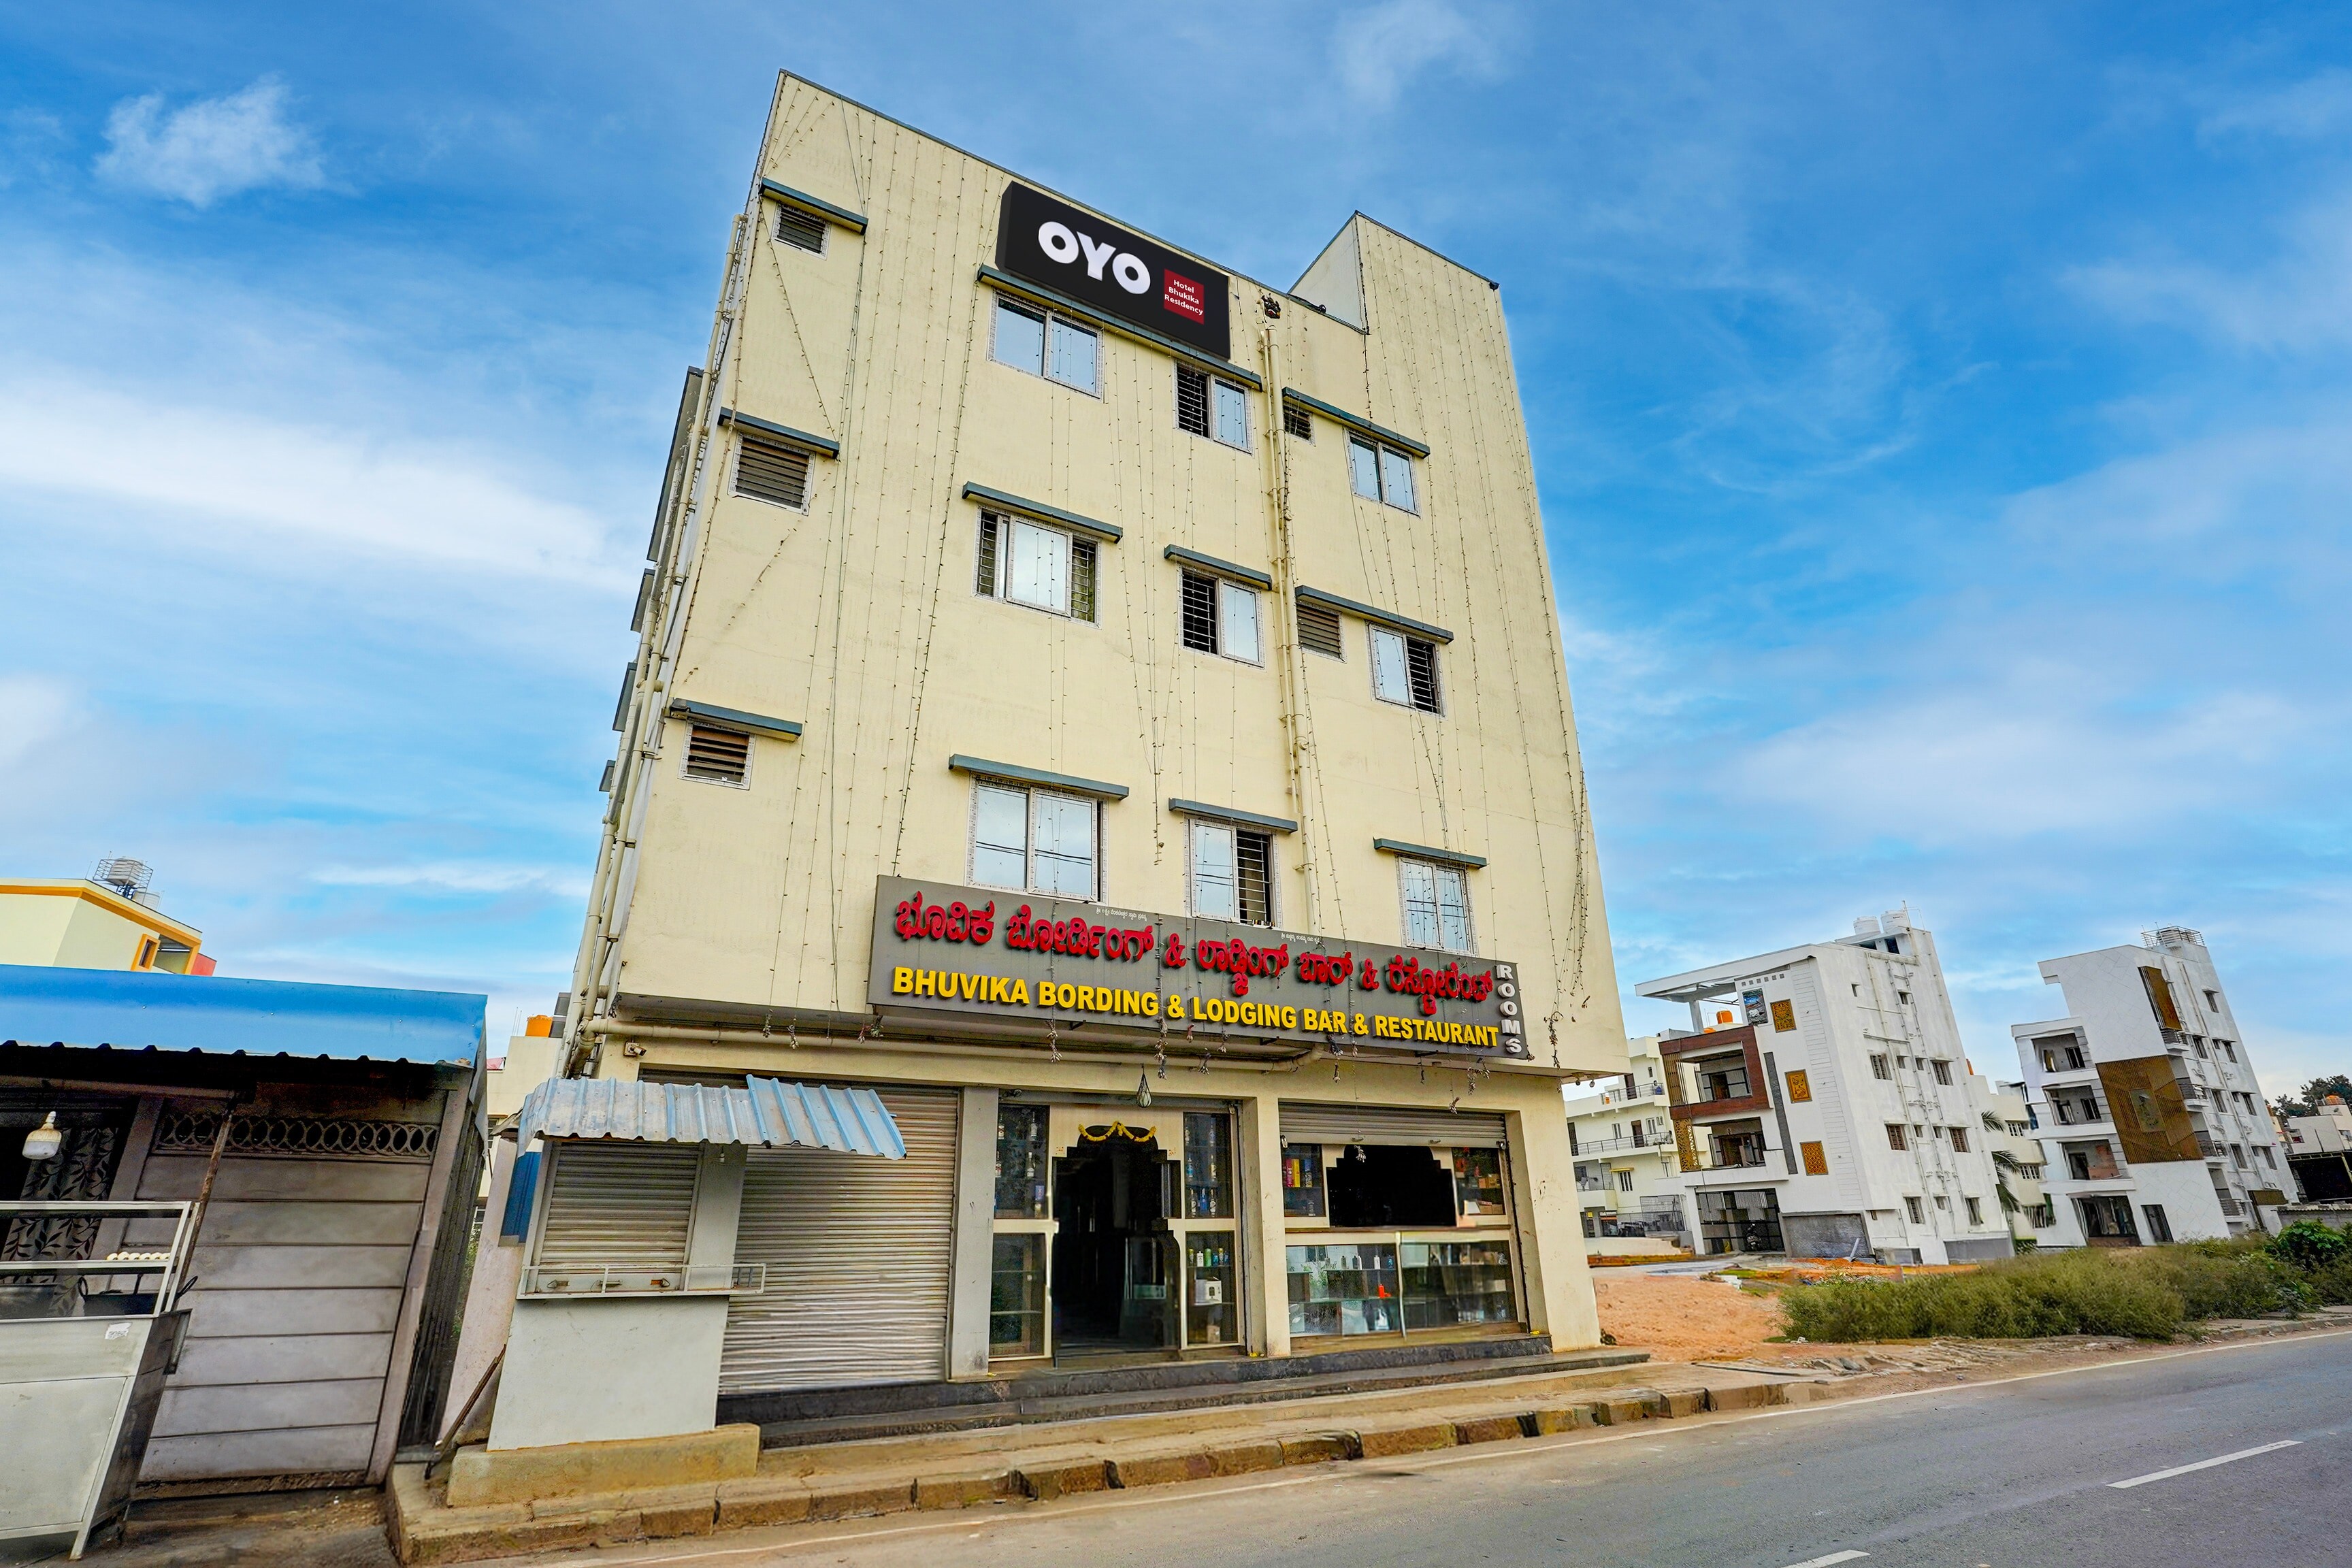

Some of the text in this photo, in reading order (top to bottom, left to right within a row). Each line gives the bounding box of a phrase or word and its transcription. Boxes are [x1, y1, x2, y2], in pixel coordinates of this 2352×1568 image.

[1038, 221, 1151, 294] OYO
[1173, 279, 1194, 293] Hotel
[1164, 294, 1204, 316] Residency
[1168, 287, 1199, 305] Bhukika
[895, 890, 1494, 1015] ಭೂವಿಕ ಬೋರ್ಡಿಂಗ್ & ಲಾಡ್ಜಿಂಗ್ ಬಾರ್ & ರೆಸ್ಟೋರೆಂಟ್
[893, 966, 1499, 1047] BHUVIKA BORDING & LODGING BAR & RESTAURANT
[1496, 964, 1522, 1054] ROOMS
